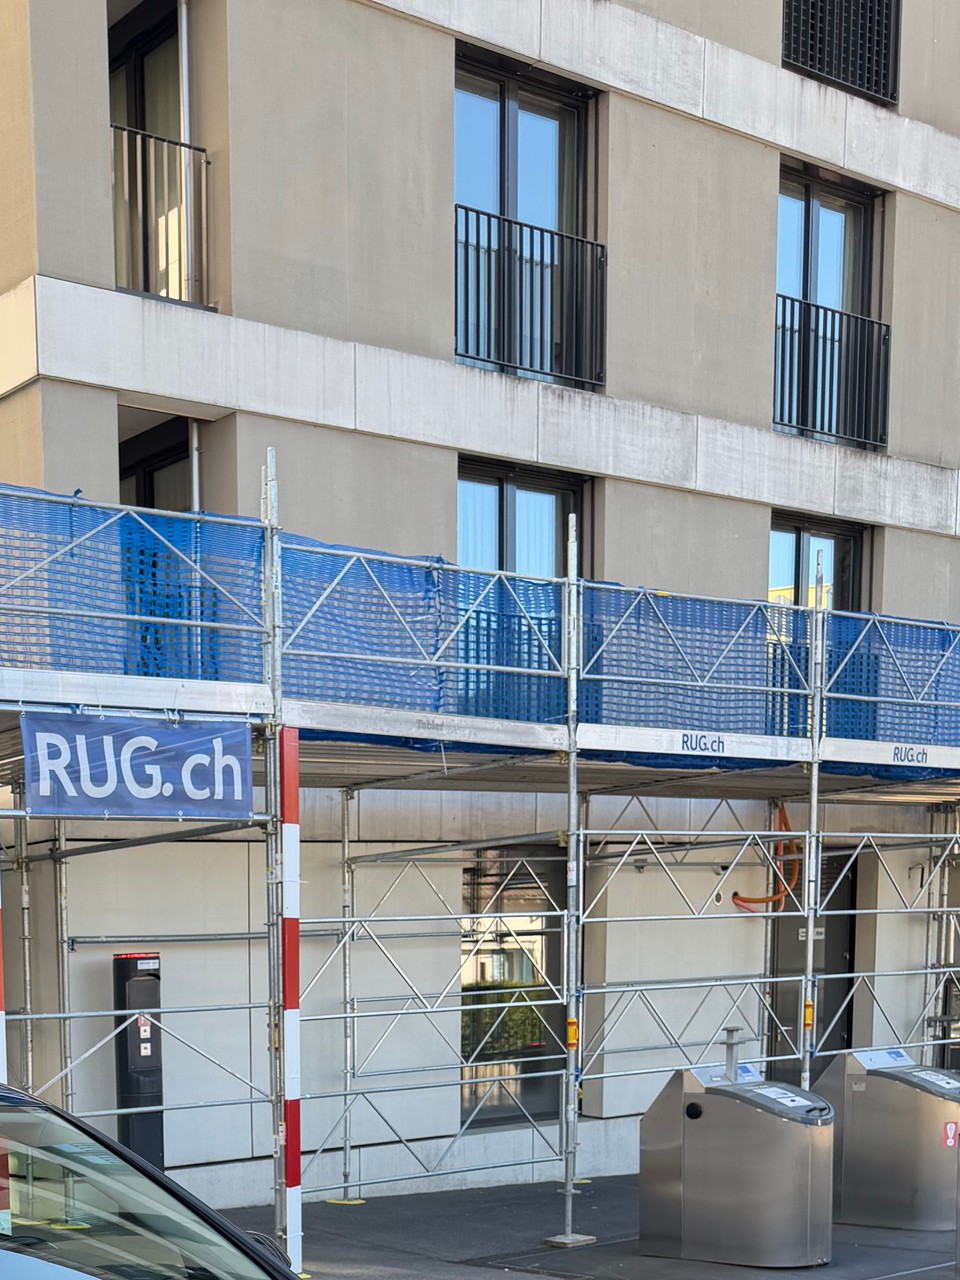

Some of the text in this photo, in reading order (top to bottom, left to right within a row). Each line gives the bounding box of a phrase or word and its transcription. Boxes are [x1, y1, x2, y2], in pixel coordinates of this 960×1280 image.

[681, 733, 725, 753] RUG.ch
[892, 746, 928, 764] RUG.ch
[35, 731, 243, 801] RUG.ch
